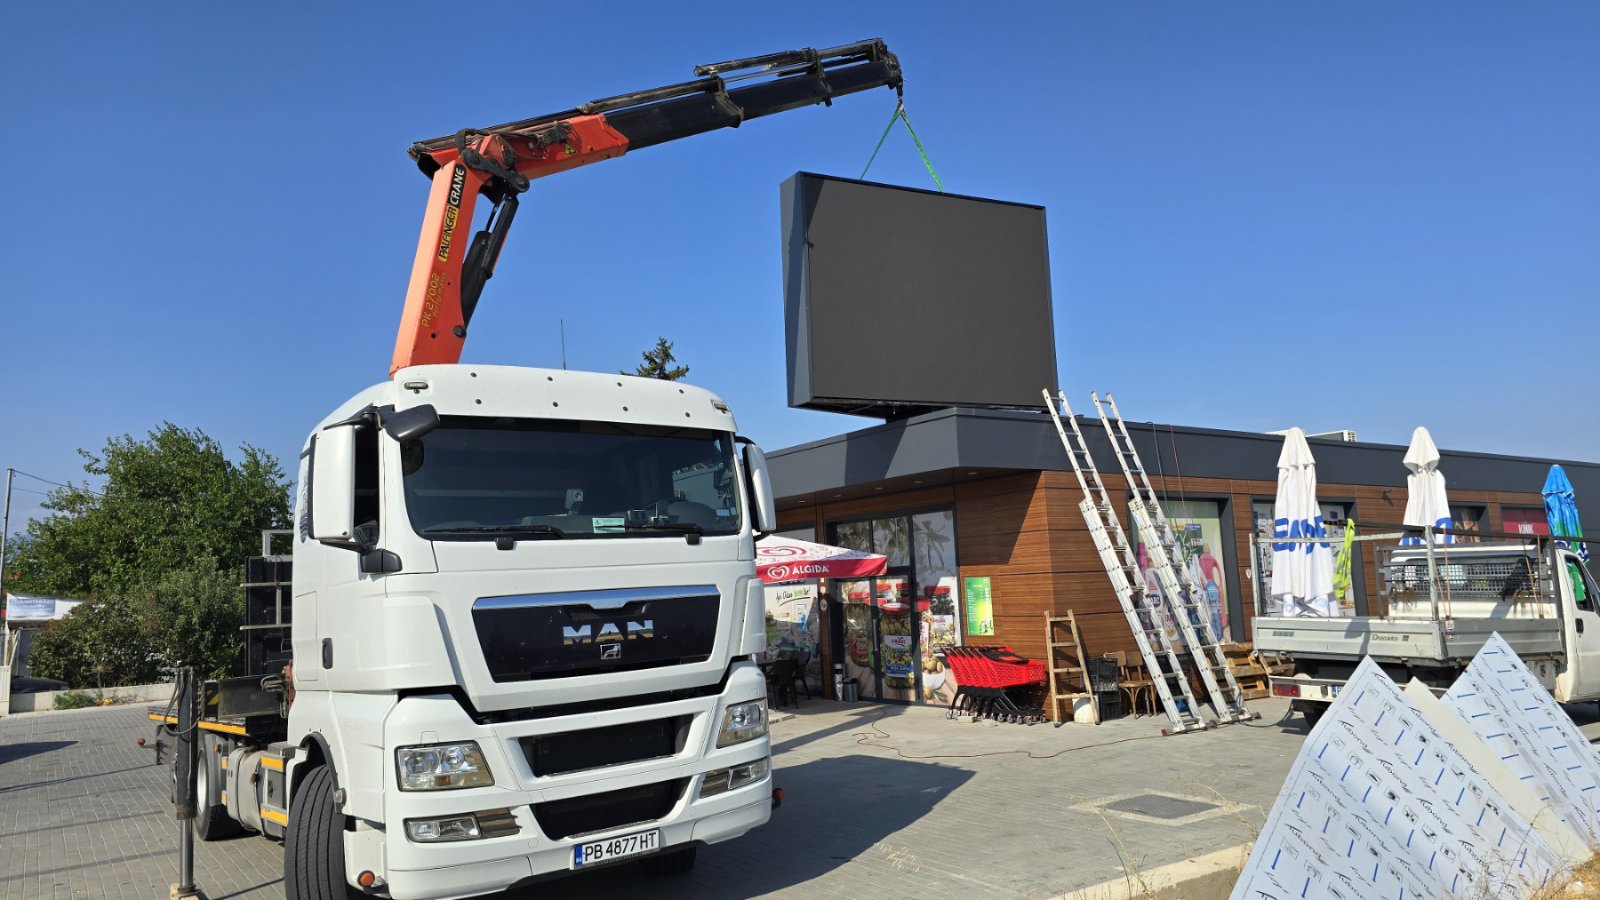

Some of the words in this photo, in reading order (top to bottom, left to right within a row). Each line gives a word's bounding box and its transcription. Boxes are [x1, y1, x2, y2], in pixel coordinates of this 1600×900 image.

[438, 205, 457, 260] PALFINGER
[450, 167, 465, 208] CRANE
[425, 273, 440, 310] 27002
[421, 312, 432, 328] PK
[792, 564, 829, 575] ALGIDA
[563, 620, 654, 645] MAN
[1338, 720, 1374, 754] Tubond
[1376, 758, 1414, 794] Tubond
[1416, 798, 1454, 834] Tubond
[584, 844, 603, 861] PB
[606, 836, 638, 856] 4877
[640, 832, 657, 849] HT
[1284, 824, 1330, 866] Tubond
